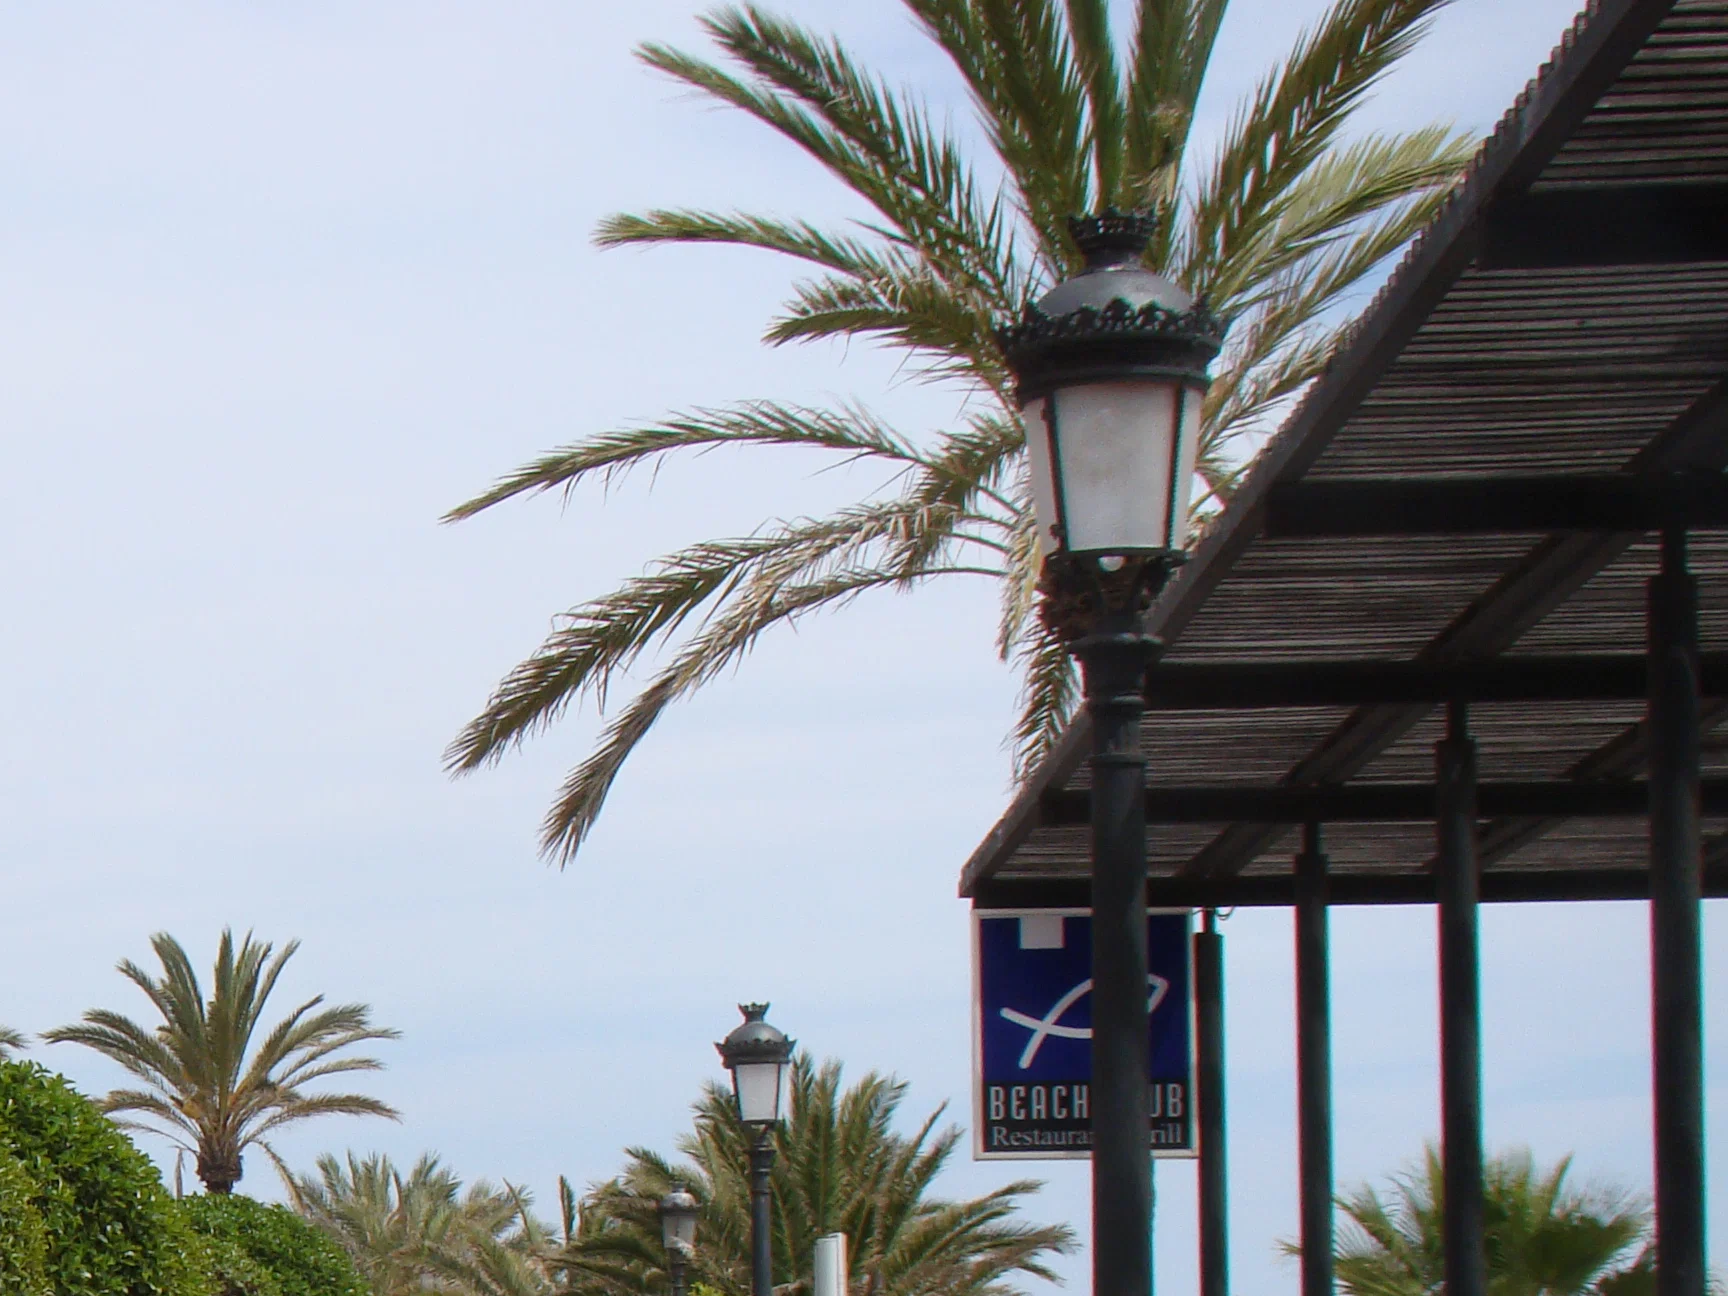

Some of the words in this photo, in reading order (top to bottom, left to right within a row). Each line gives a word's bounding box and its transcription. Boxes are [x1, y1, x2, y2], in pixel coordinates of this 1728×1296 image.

[989, 1085, 1090, 1120] BEACH
[1149, 1083, 1184, 1118] UB
[991, 1126, 1094, 1146] Restaura
[1149, 1123, 1183, 1145] rill
